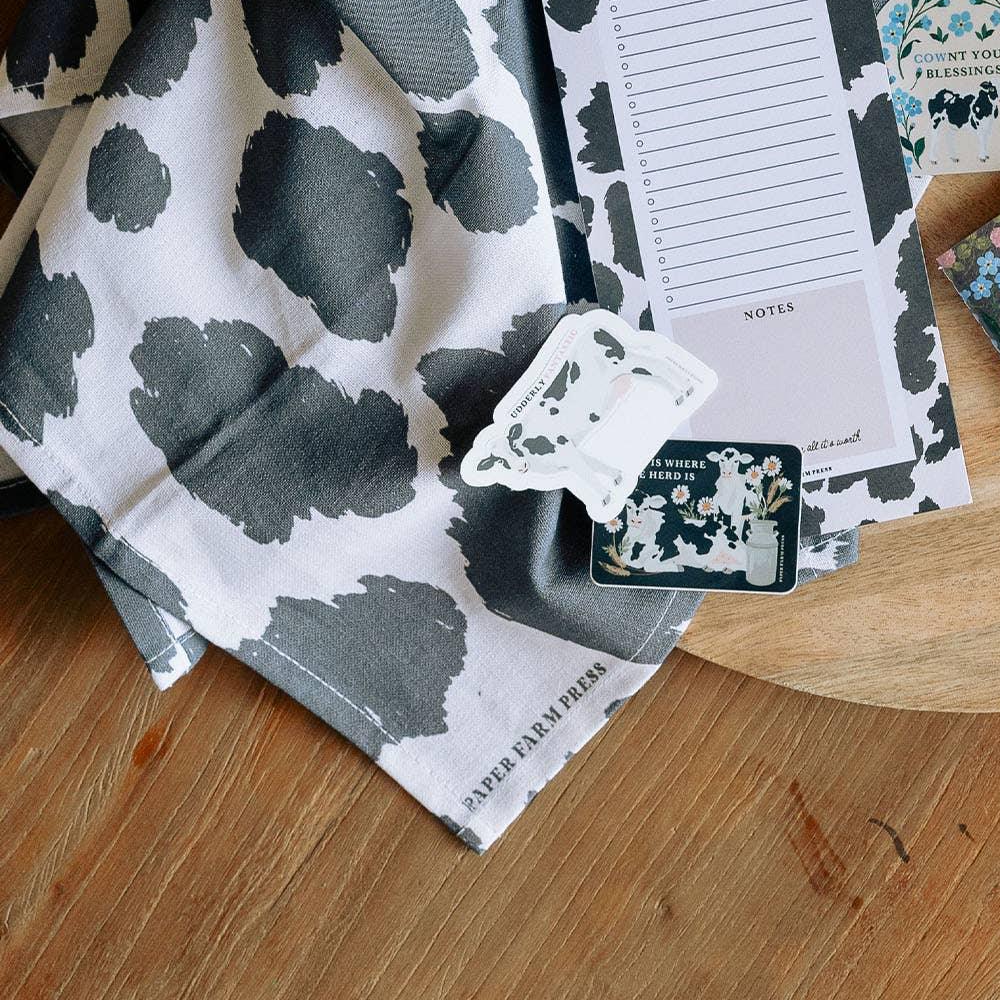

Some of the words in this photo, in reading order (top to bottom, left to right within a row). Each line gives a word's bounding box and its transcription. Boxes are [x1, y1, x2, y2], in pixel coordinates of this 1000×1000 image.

[913, 50, 967, 64] COWNT
[743, 302, 795, 320] NOTES
[510, 378, 545, 418] UDDERLY
[806, 440, 819, 452] all
[836, 428, 862, 446] worth
[650, 458, 661, 468] IS
[664, 459, 707, 470] WHERE
[649, 470, 682, 481] HERD
[684, 472, 695, 481] IS
[462, 757, 516, 813] PAPER
[511, 705, 562, 759] FARM
[558, 662, 608, 711] PRESS
